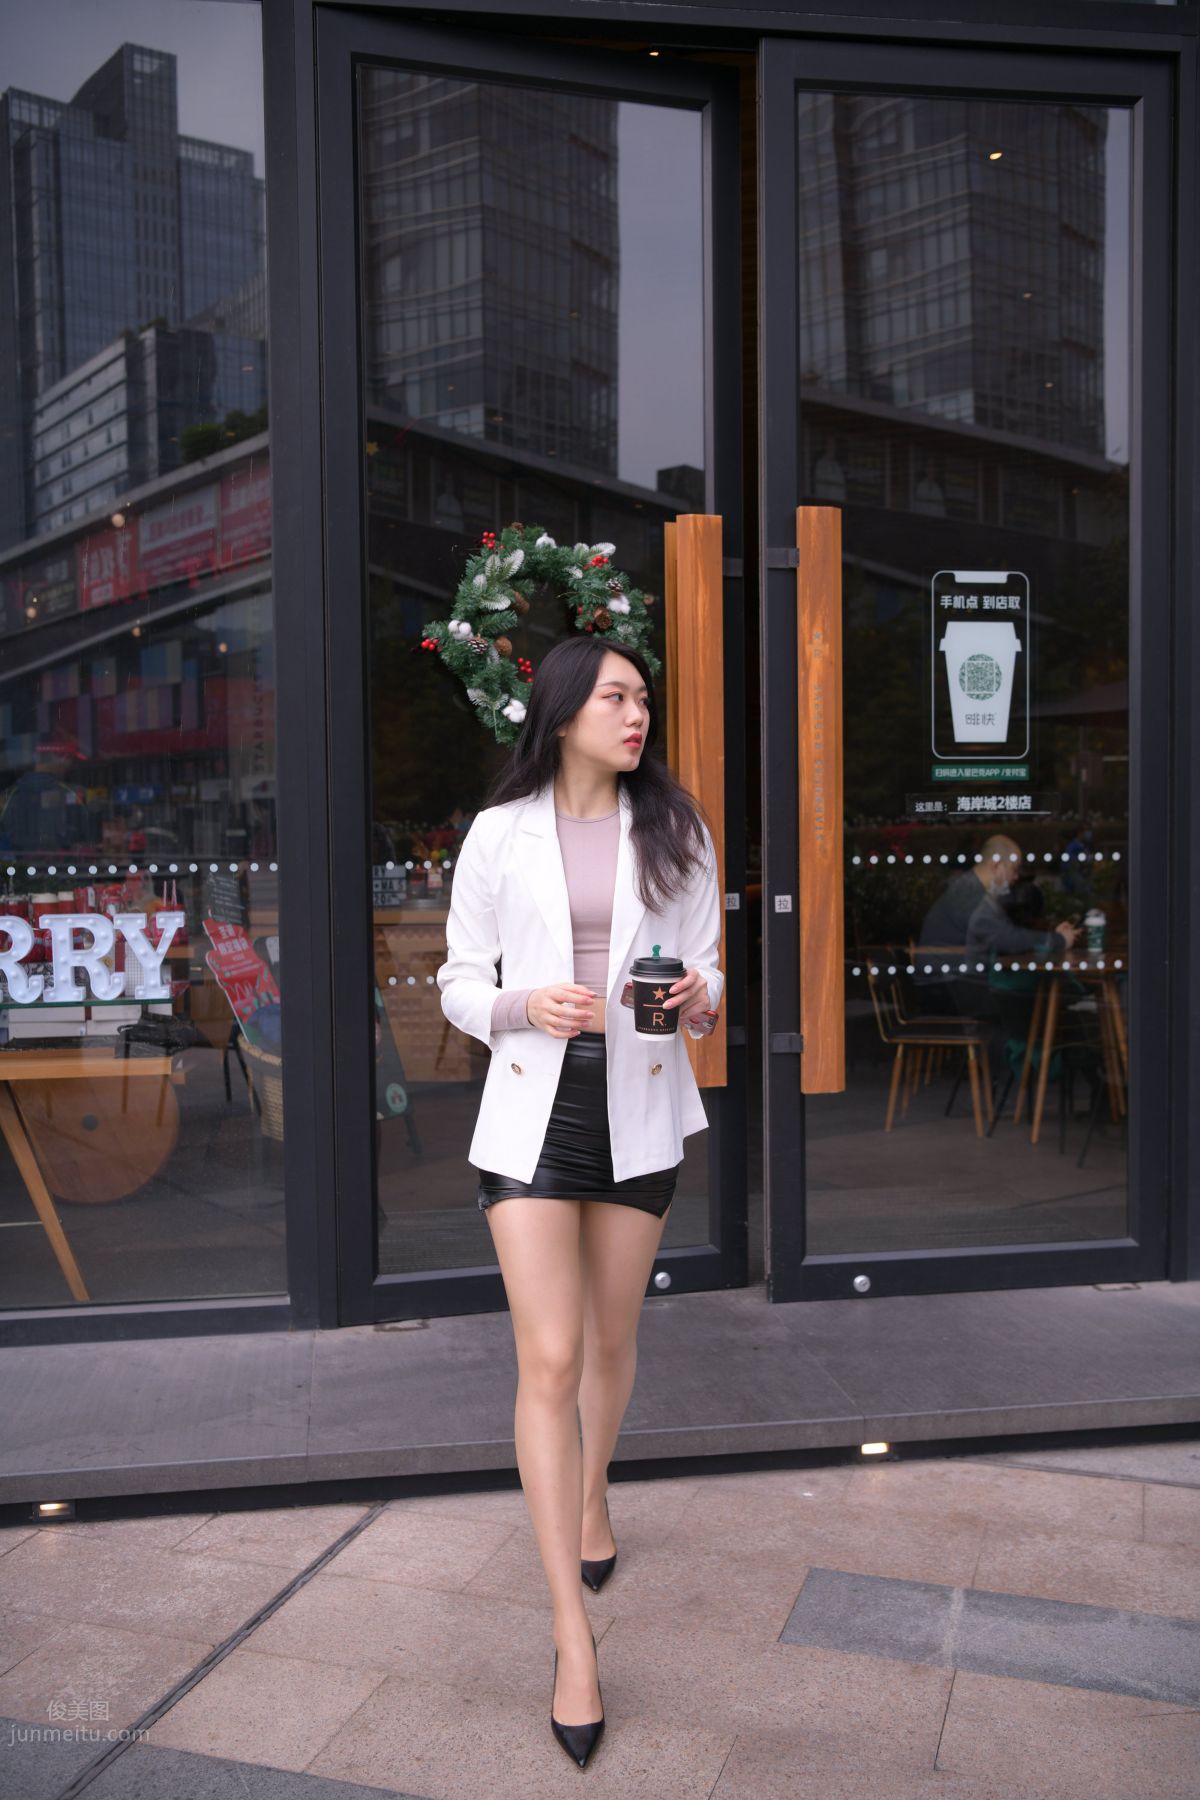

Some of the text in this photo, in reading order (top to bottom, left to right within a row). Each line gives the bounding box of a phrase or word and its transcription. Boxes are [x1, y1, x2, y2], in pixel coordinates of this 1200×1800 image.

[940, 595, 1021, 609] 手机点 到店取
[957, 795, 1032, 811] 海岸城2楼店
[776, 898, 790, 910] 拉
[0, 911, 185, 1004] RRY
[652, 1012, 665, 1027] R
